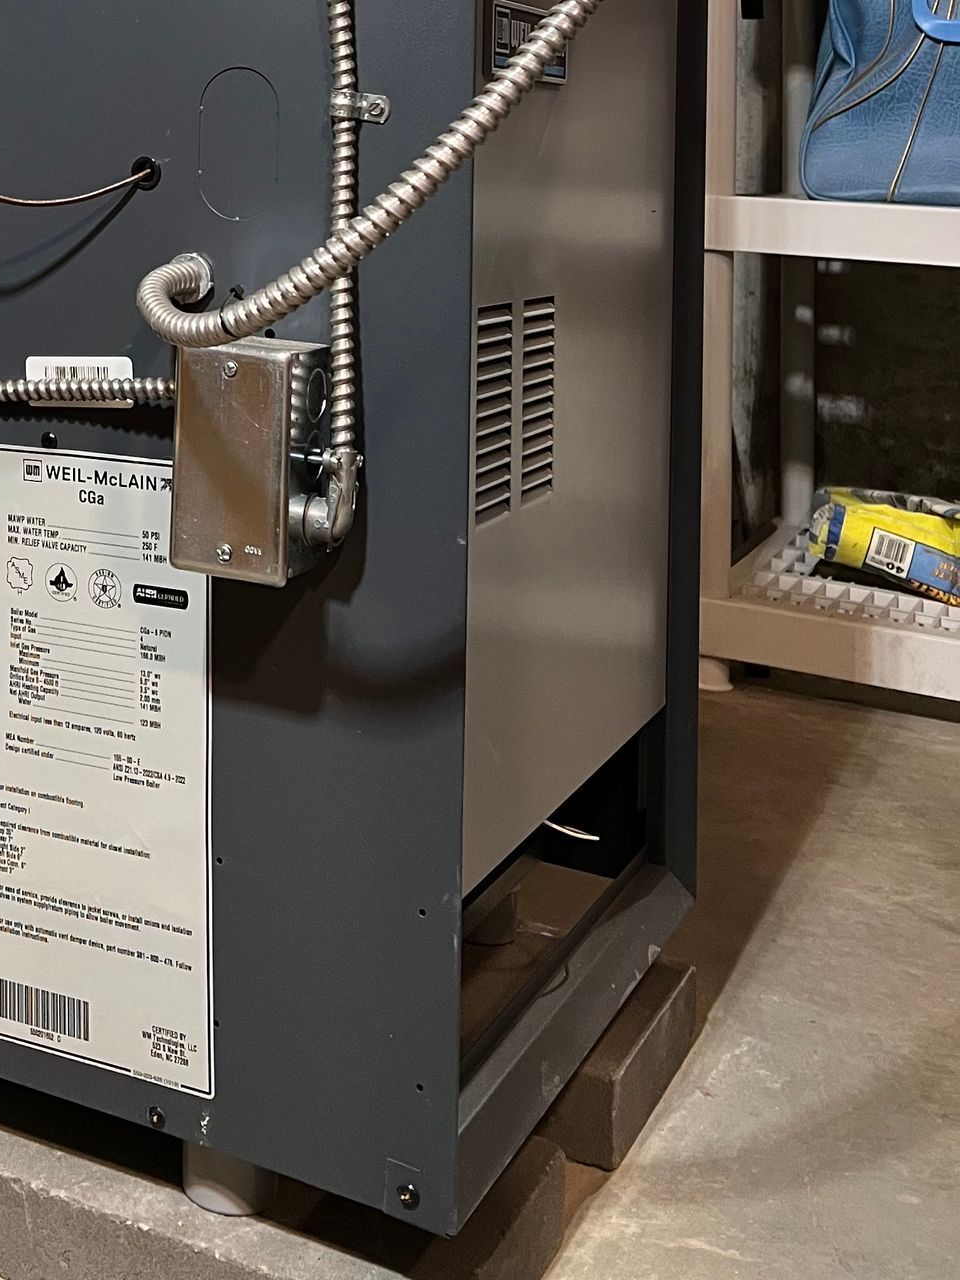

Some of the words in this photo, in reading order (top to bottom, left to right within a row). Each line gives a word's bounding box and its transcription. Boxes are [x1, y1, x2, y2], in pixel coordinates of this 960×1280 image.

[46, 465, 157, 491] WEIL-McLAIN
[79, 490, 104, 505] CGa
[8, 514, 25, 524] MAWP
[27, 517, 46, 526] WATER
[142, 531, 149, 539] 50
[151, 532, 160, 540] PSI
[8, 525, 21, 535] MAX.
[23, 527, 41, 537] WATER
[44, 530, 60, 540] TEMP.
[142, 542, 152, 550] 250
[154, 543, 157, 551] F
[8, 536, 20, 545] MIN.
[22, 538, 40, 547] RELIEF
[42, 540, 58, 550] VALVE
[60, 542, 87, 553] CAPACITY
[143, 553, 152, 562] 141
[154, 554, 167, 564] MBH
[10, 608, 24, 616] Boiler
[25, 610, 38, 618] Model
[10, 616, 24, 624] Series
[10, 624, 21, 633] Type
[28, 626, 36, 634] Gas
[140, 644, 157, 652] Natural
[10, 632, 22, 641] Input
[154, 654, 165, 662] MBH
[19, 650, 40, 659] Maximum
[21, 643, 30, 651] Gas
[31, 644, 50, 654] Pressure
[19, 658, 39, 667] Minimum
[10, 665, 29, 674] Manifold
[30, 668, 38, 676] Gas
[40, 670, 59, 679] Pressure
[10, 672, 24, 681] Orifice
[25, 675, 34, 683] Size
[10, 680, 21, 688] AHRI
[22, 683, 39, 693] Heating
[40, 685, 59, 696] Capacity
[150, 704, 161, 713] MBH
[18, 691, 29, 699] AHRI
[31, 692, 45, 701] Output
[18, 697, 31, 705] Water
[150, 720, 161, 729] MBH
[9, 711, 29, 721] Electrical
[30, 715, 42, 724] input
[43, 717, 52, 725] less
[53, 719, 63, 727] than
[94, 726, 102, 734] 120
[103, 730, 115, 738] volts,
[124, 733, 136, 741] hertz
[6, 733, 15, 741] MEA
[17, 735, 34, 744] Number
[5, 743, 20, 753] Design
[22, 746, 39, 756] certified
[41, 750, 53, 759] under
[113, 764, 123, 772] ANSI
[113, 774, 122, 782] Low
[124, 775, 144, 786] Pressure
[146, 780, 160, 789] Boiler
[5, 785, 29, 796] installation
[38, 792, 64, 803] combustible
[8, 803, 27, 814] Category
[18, 823, 38, 834] clearance
[40, 828, 50, 836] from
[52, 832, 79, 843] combustible
[81, 838, 99, 848] material
[109, 843, 122, 853] closet
[17, 896, 32, 905] system
[64, 908, 78, 918] piping
[100, 916, 113, 925] boiler
[40, 894, 57, 903] provide
[59, 898, 80, 909] clearance
[162, 922, 170, 931] and
[172, 925, 192, 936] isolation
[14, 921, 23, 930] only
[35, 927, 57, 938] automatic
[70, 935, 87, 944] damper
[117, 946, 135, 957] number
[176, 960, 192, 971] Follow
[142, 1031, 152, 1039] WM
[188, 1044, 197, 1052] LLC
[152, 1026, 178, 1039] CERTIFIED
[179, 1033, 186, 1041] BY
[151, 1049, 164, 1061] Eden,
[166, 1053, 173, 1062] NC
[152, 1042, 160, 1050] 523
[168, 1046, 178, 1055] New
